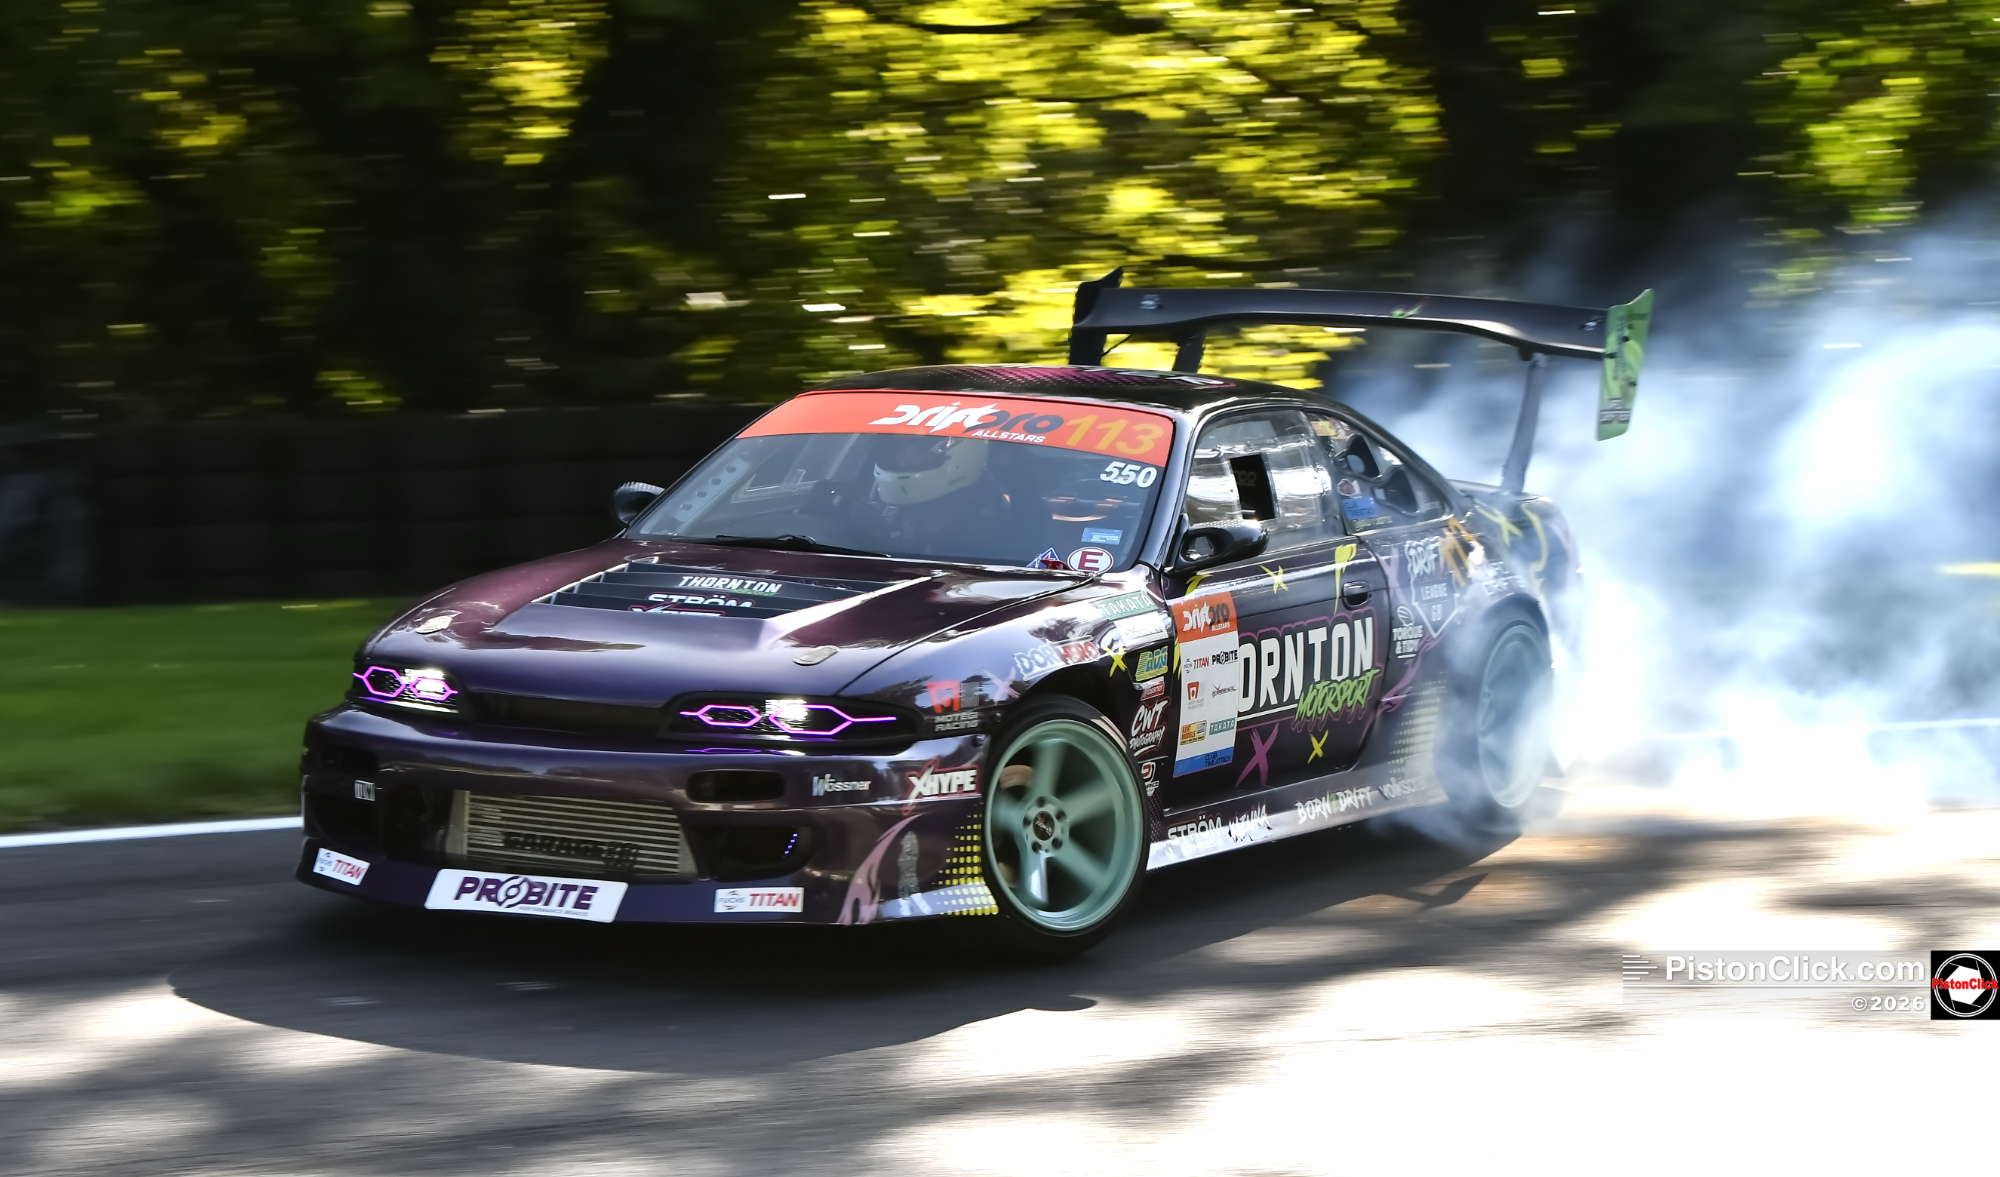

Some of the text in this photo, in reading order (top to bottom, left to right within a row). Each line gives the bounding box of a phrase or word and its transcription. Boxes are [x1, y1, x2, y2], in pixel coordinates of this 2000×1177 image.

[972, 429, 1046, 443] ALLSTARS
[1066, 414, 1165, 455] 113
[1100, 460, 1158, 488] 550
[1078, 551, 1103, 572] E
[678, 576, 782, 594] THORNTON
[1100, 592, 1155, 616] TAKATA
[1193, 657, 1209, 670] TITAN
[1212, 649, 1238, 666] PROBITE
[1238, 617, 1373, 712] ORNTON
[1295, 669, 1381, 722] MOTORSPORT
[935, 711, 979, 723] MOTEGI
[935, 720, 979, 732] RACING
[1131, 700, 1168, 737] CWT
[1210, 719, 1235, 733] TAKATA
[906, 763, 977, 807] XHYPE
[1168, 814, 1226, 842] STRÖM
[332, 859, 366, 879] TITAN
[454, 876, 600, 910] PROBITE
[750, 893, 798, 907] TITAN
